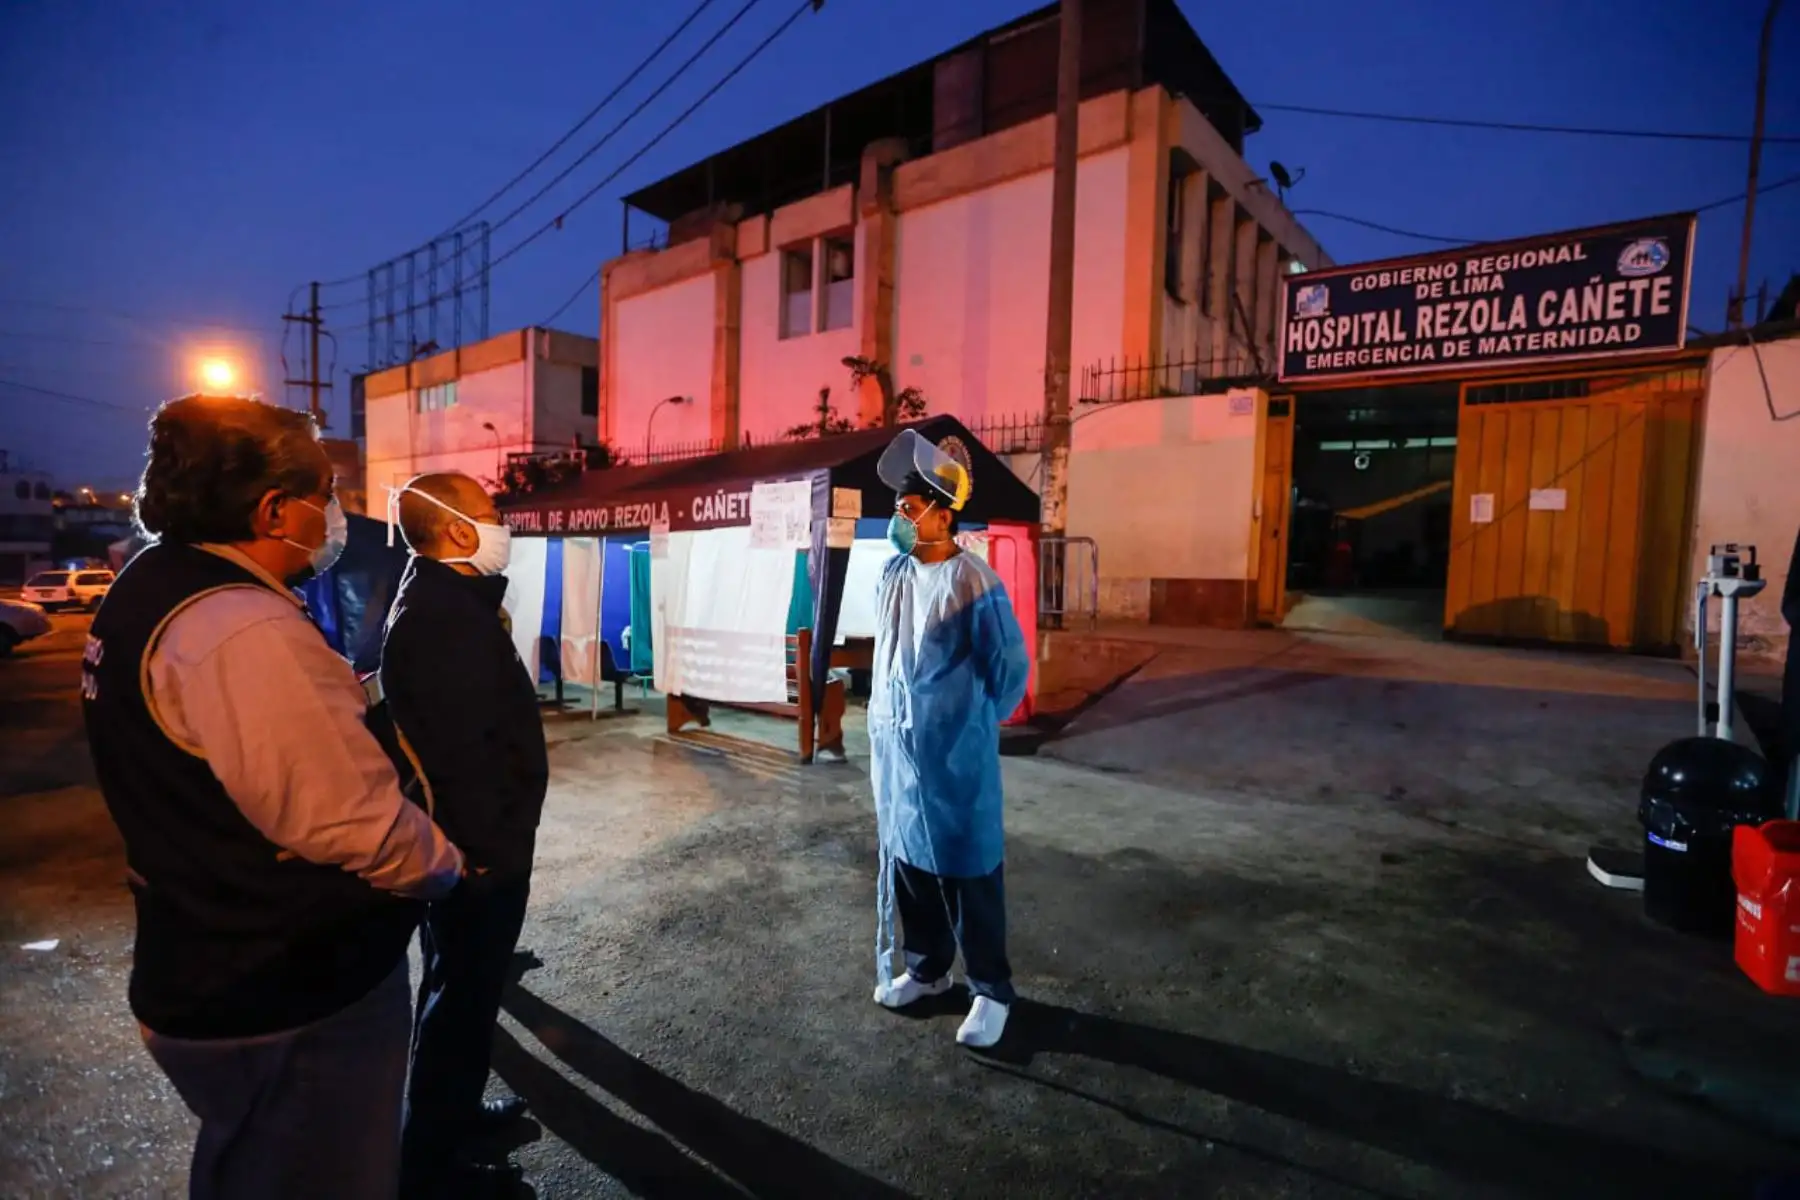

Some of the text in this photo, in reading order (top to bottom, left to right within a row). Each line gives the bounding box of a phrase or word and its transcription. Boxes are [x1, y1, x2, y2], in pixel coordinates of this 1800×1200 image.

[1350, 262, 1458, 292] GOBIERNO
[1465, 243, 1587, 276] REGIONAL
[1415, 274, 1504, 300] DE LIMA
[1288, 274, 1673, 353] HOSPITAL REZOLA CAÑETE
[1305, 323, 1641, 370] EMERGENCIA DE MATERNIDAD
[548, 510, 564, 532] DE
[568, 508, 608, 531] APOYO
[615, 500, 670, 529] REZOLA
[692, 489, 752, 522] CAÑET
